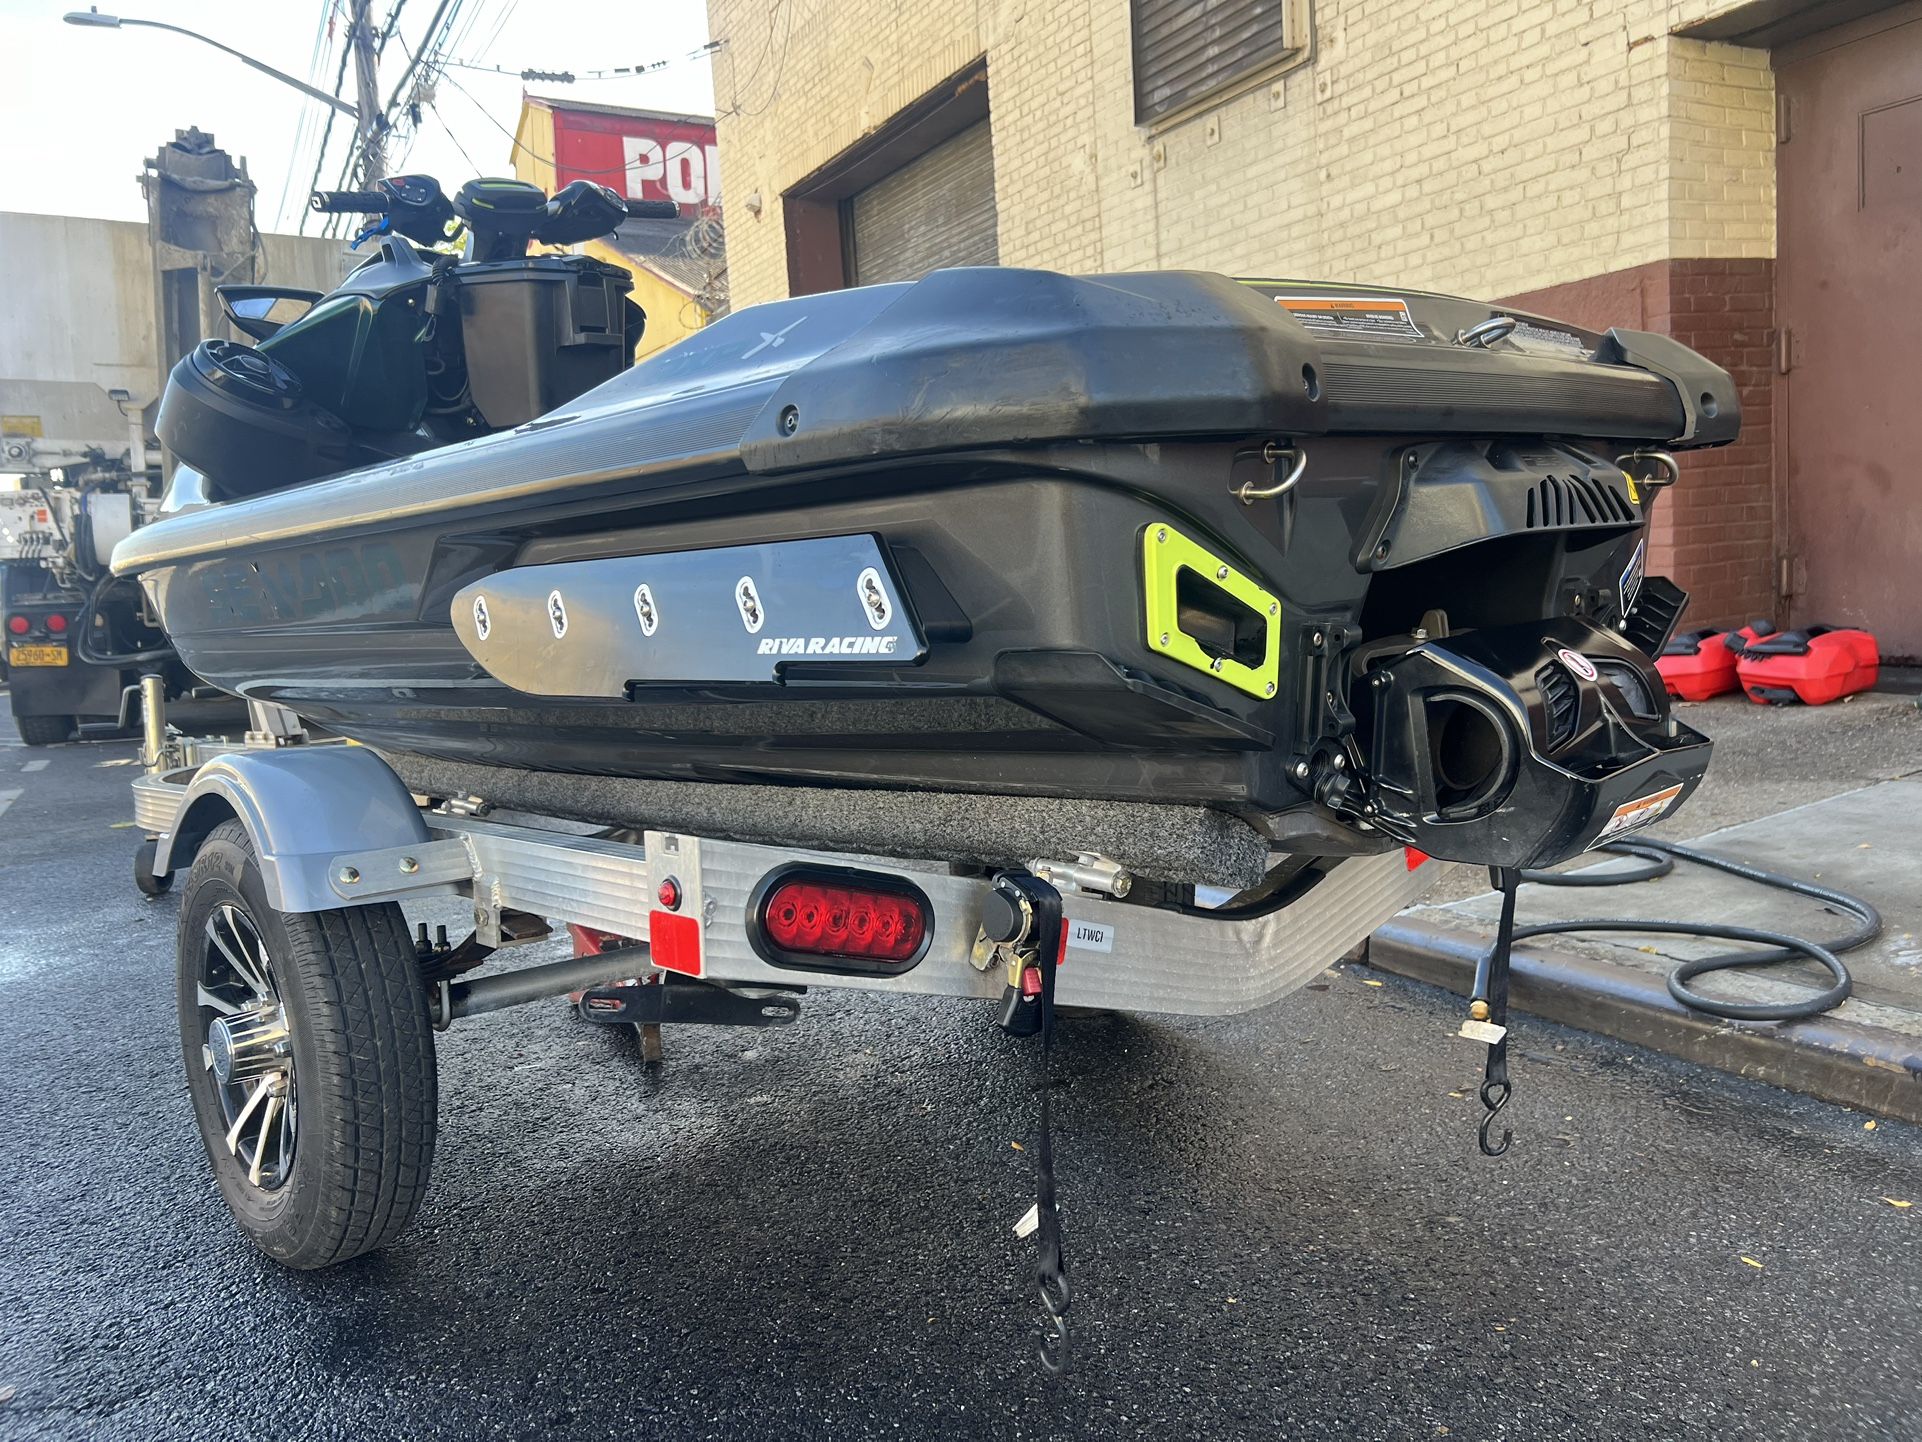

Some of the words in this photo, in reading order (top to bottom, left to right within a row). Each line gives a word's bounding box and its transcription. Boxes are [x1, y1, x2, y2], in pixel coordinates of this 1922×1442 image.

[757, 637, 805, 655] RIVA
[805, 636, 897, 655] RACING
[1077, 927, 1104, 943] LTWCI
